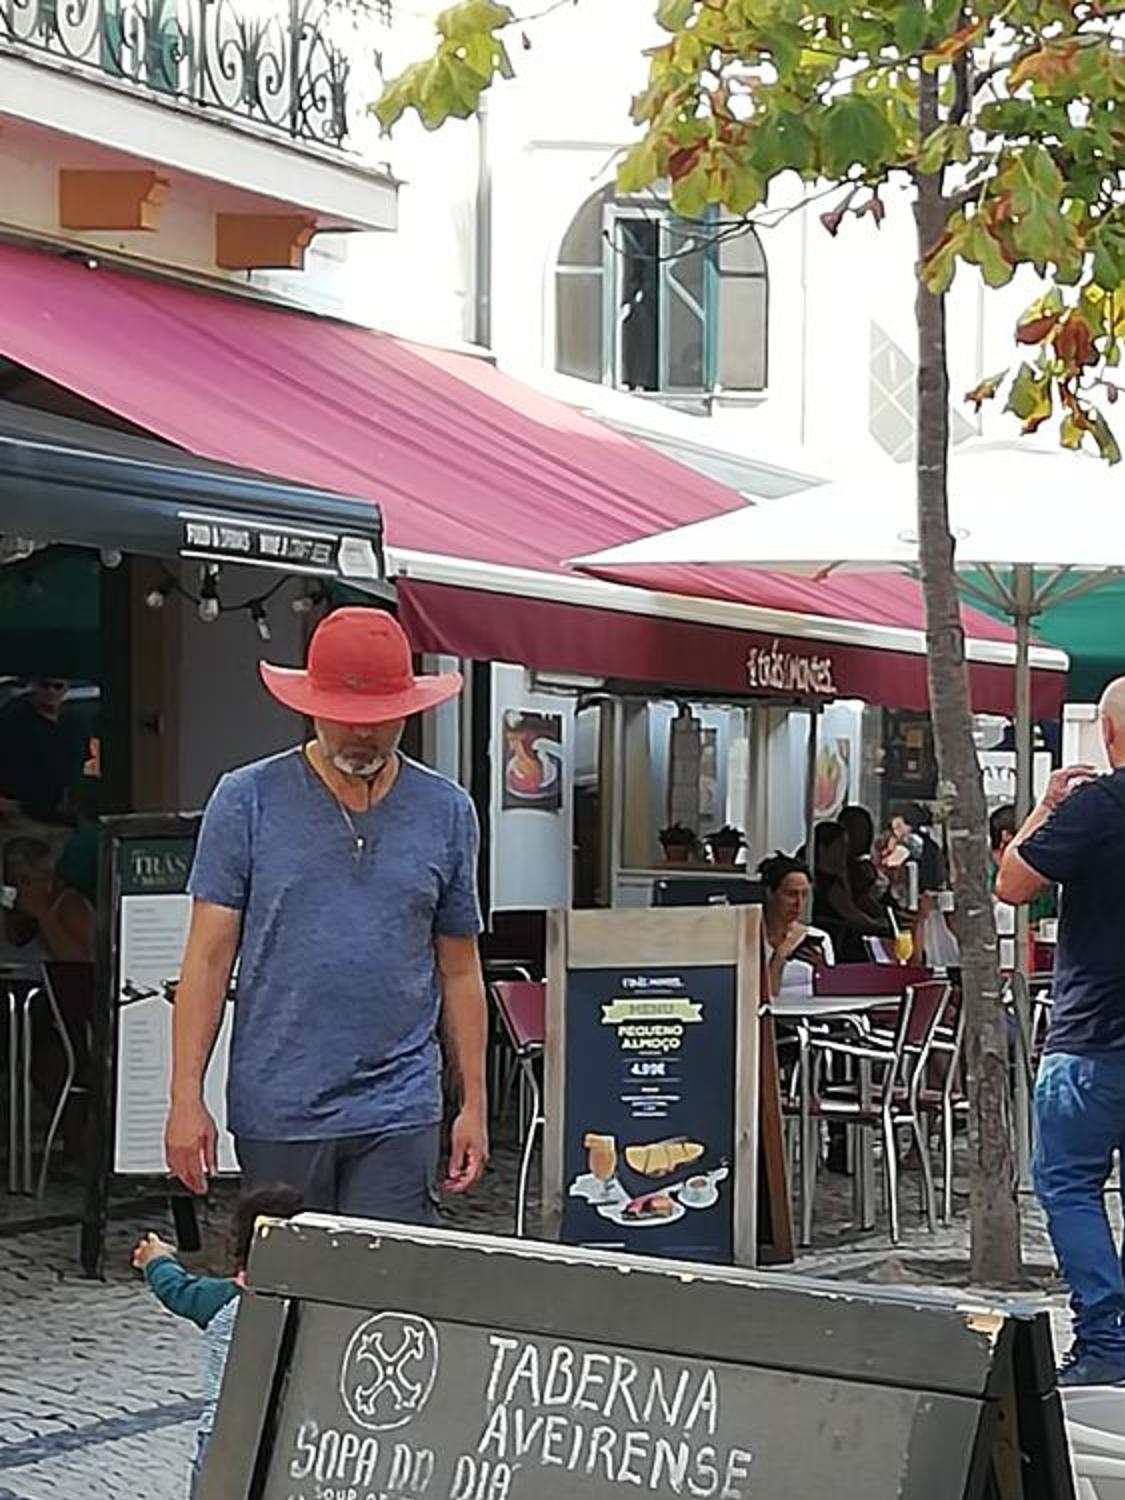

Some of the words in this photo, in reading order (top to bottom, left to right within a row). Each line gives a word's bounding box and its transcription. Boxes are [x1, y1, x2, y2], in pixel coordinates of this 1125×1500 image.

[617, 1025, 683, 1038] PEQUENO
[621, 1037, 681, 1052] ALMOÇO
[486, 1335, 720, 1436] TABERNA
[291, 1421, 379, 1487] SOPA
[387, 1443, 435, 1492] DO
[478, 1403, 754, 1500] AVEIRENSE
